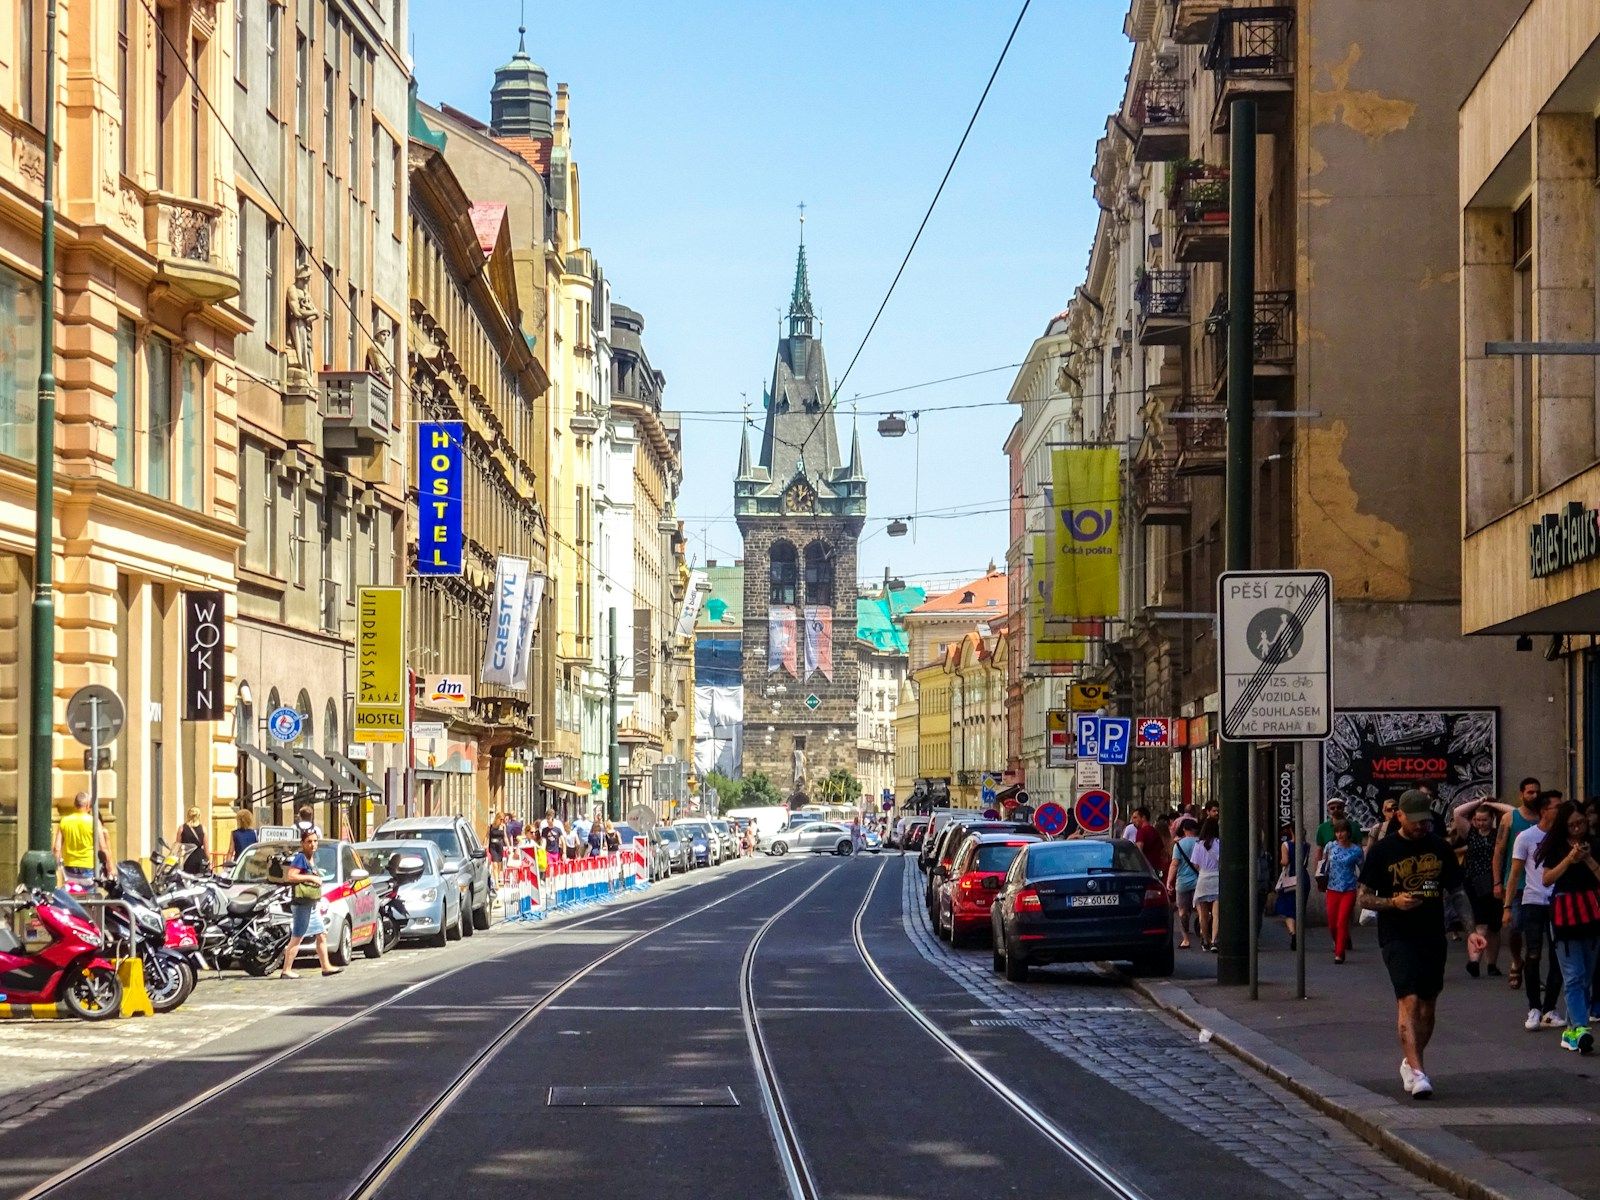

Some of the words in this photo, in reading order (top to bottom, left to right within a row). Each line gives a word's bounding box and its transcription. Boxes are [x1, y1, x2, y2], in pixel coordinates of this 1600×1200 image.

[430, 431, 451, 567] HOSTEL
[1561, 502, 1596, 566] Fleurs
[1062, 543, 1084, 555] Čeká
[1085, 545, 1112, 556] pošta
[1231, 580, 1268, 599] PĚŠÍ
[493, 573, 517, 671] CRESTYL
[361, 591, 377, 691] JINDŘIŠSKÁ
[190, 602, 220, 710] WOKIN
[635, 647, 649, 677] NYX
[437, 678, 462, 694] dm
[361, 692, 398, 702] PASAŽ
[1259, 692, 1306, 702] VOZIDLA
[357, 713, 401, 725] HOSTEL
[1251, 706, 1320, 717] SOUHLASEM
[1081, 720, 1096, 746] P
[1138, 719, 1168, 736] EXCHANGE
[1263, 722, 1301, 732] PRAHA
[1104, 723, 1124, 751] P
[1072, 895, 1090, 907] PSZ
[1091, 895, 1118, 905] 60169
